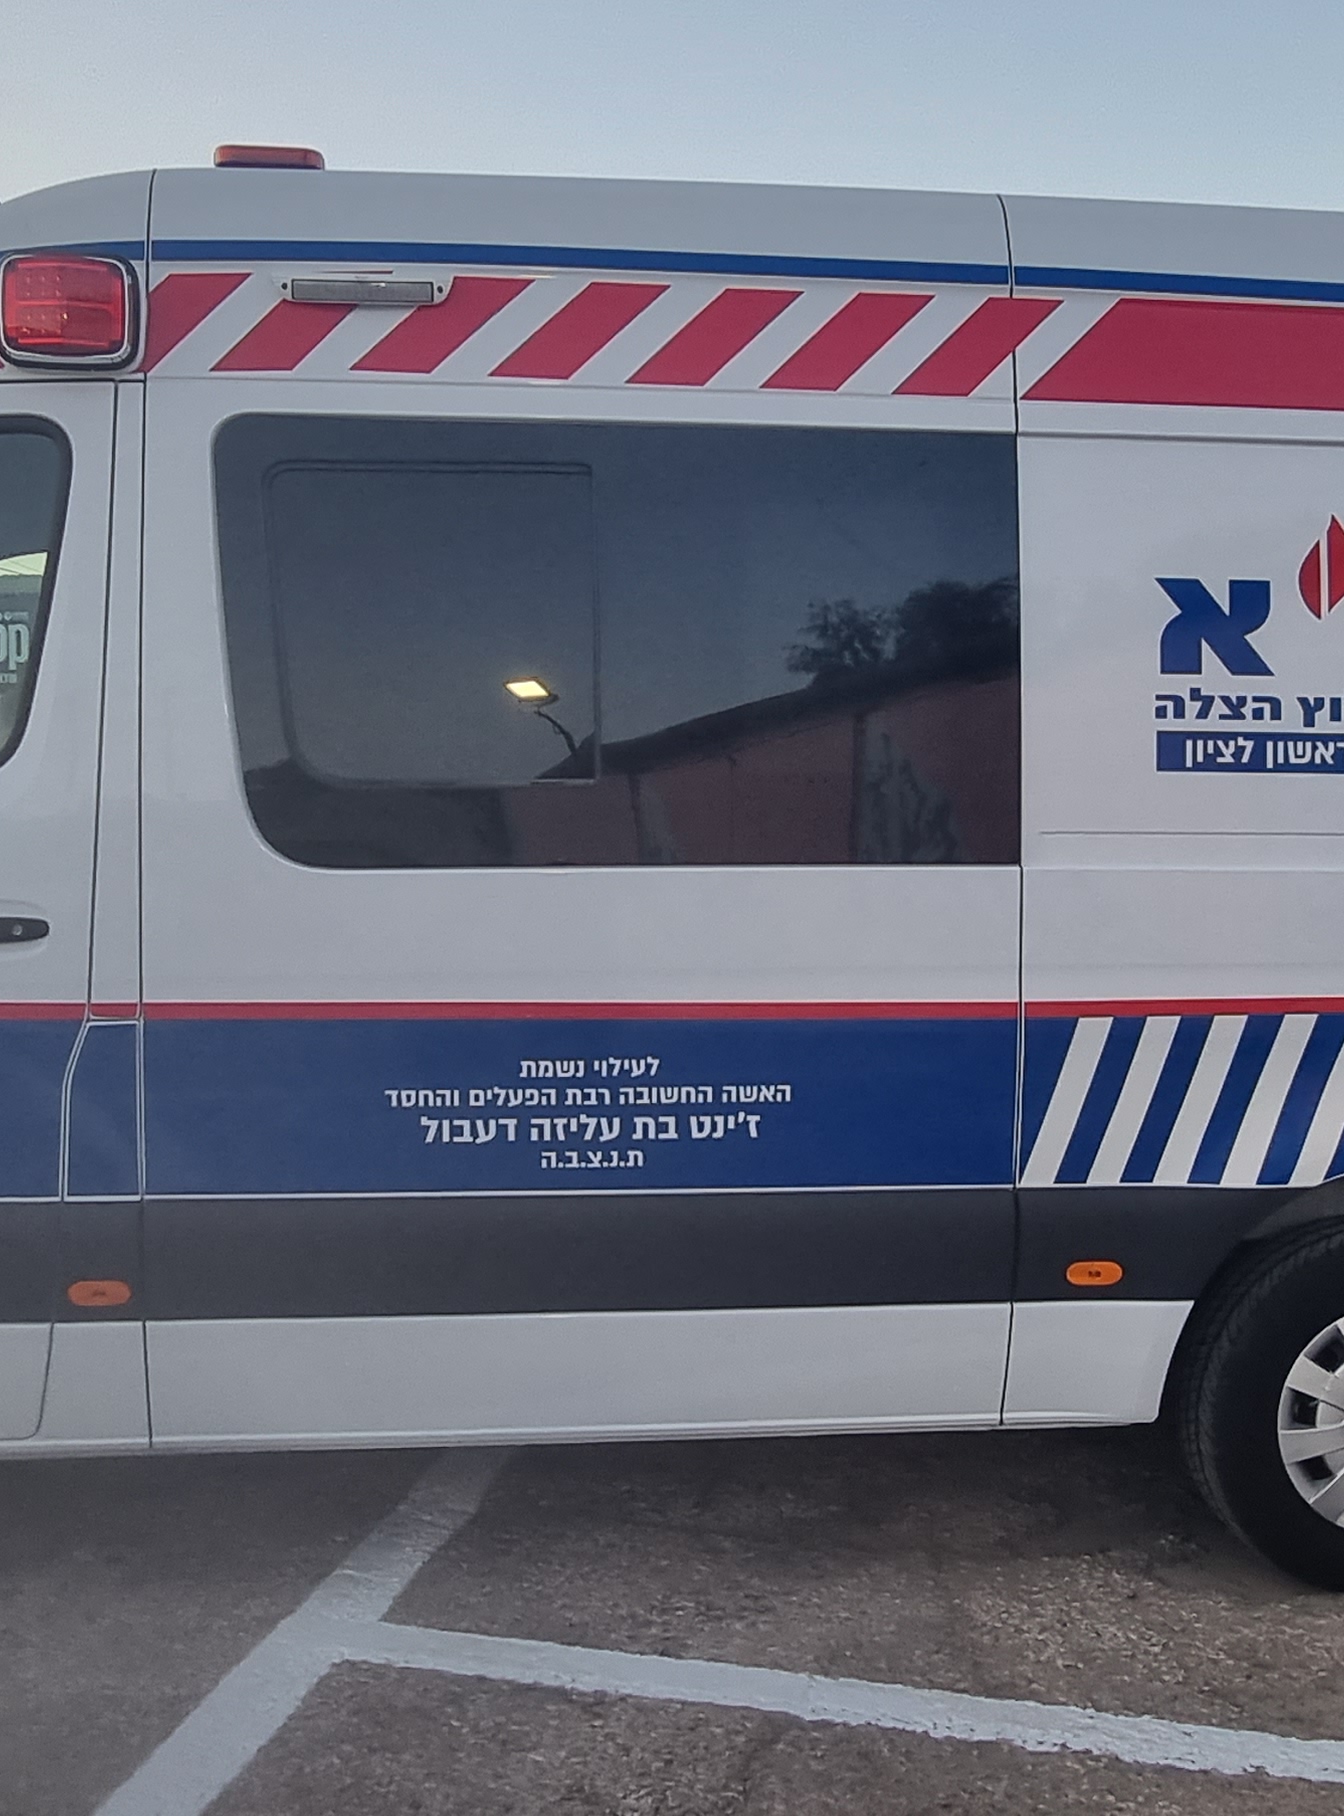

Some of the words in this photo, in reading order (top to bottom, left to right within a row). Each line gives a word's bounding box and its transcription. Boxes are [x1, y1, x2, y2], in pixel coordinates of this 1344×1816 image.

[1154, 688, 1281, 722] הצלה
[1184, 736, 1254, 767] לציון
[519, 1058, 584, 1078] נשמת
[593, 1056, 660, 1077] לעילוי
[384, 1088, 459, 1108] והחסד
[469, 1086, 556, 1107] הפעלים
[564, 1087, 610, 1106] רבת
[619, 1085, 712, 1105] החשובה
[721, 1084, 791, 1104] האשה
[420, 1115, 518, 1145] דעבול
[530, 1114, 620, 1142] עליזה
[631, 1116, 678, 1140] בת
[540, 1150, 644, 1169] ת.נ.צ.ב.ה
